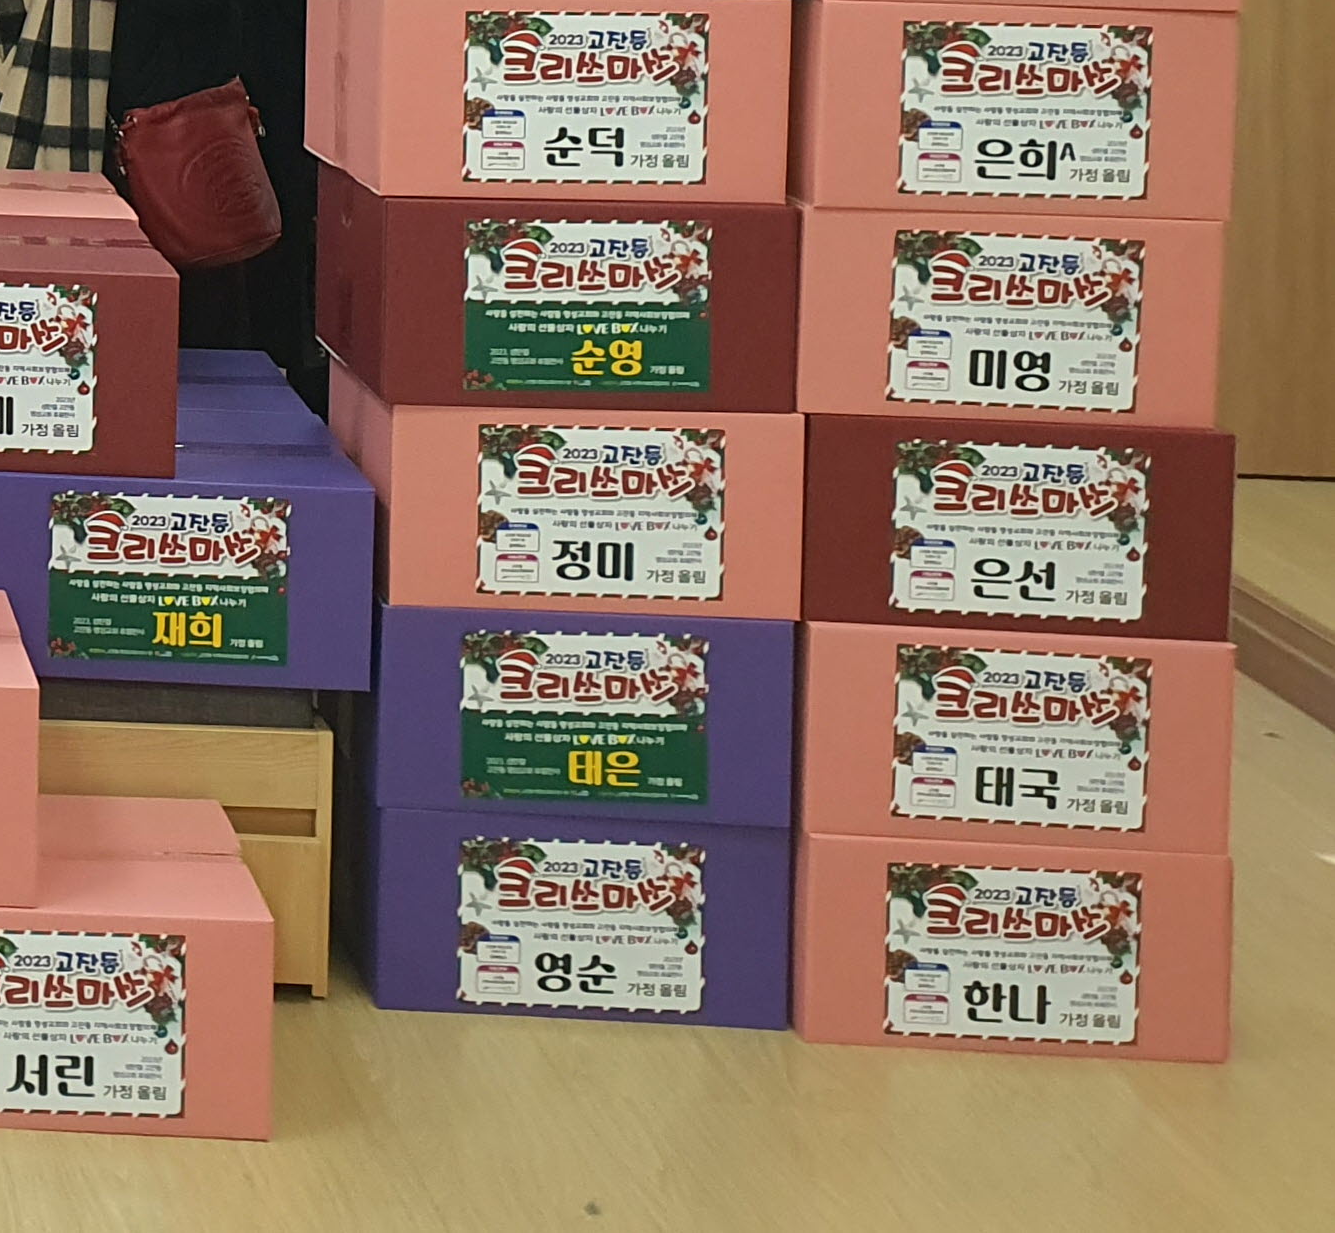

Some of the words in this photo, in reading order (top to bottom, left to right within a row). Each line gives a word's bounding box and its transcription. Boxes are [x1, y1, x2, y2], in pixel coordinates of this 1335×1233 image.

[543, 127, 624, 166] 순덕
[630, 154, 658, 168] 가정
[662, 154, 689, 168] 올림
[573, 340, 642, 375] 순영
[969, 349, 1050, 392] 미영
[562, 448, 598, 460] 2023
[602, 444, 664, 465] 고잔동
[552, 540, 633, 581] 정미
[971, 558, 1055, 601] 은선
[1066, 589, 1095, 604] 가정
[1099, 590, 1128, 605] 올림
[153, 611, 221, 647] 재희
[569, 751, 639, 786] 태은
[975, 766, 1060, 809] 태국
[535, 952, 616, 994] 영순
[628, 982, 656, 997] 가정
[659, 983, 687, 998] 올림
[963, 980, 1051, 1024] 한나
[7, 1054, 94, 1097] 서린
